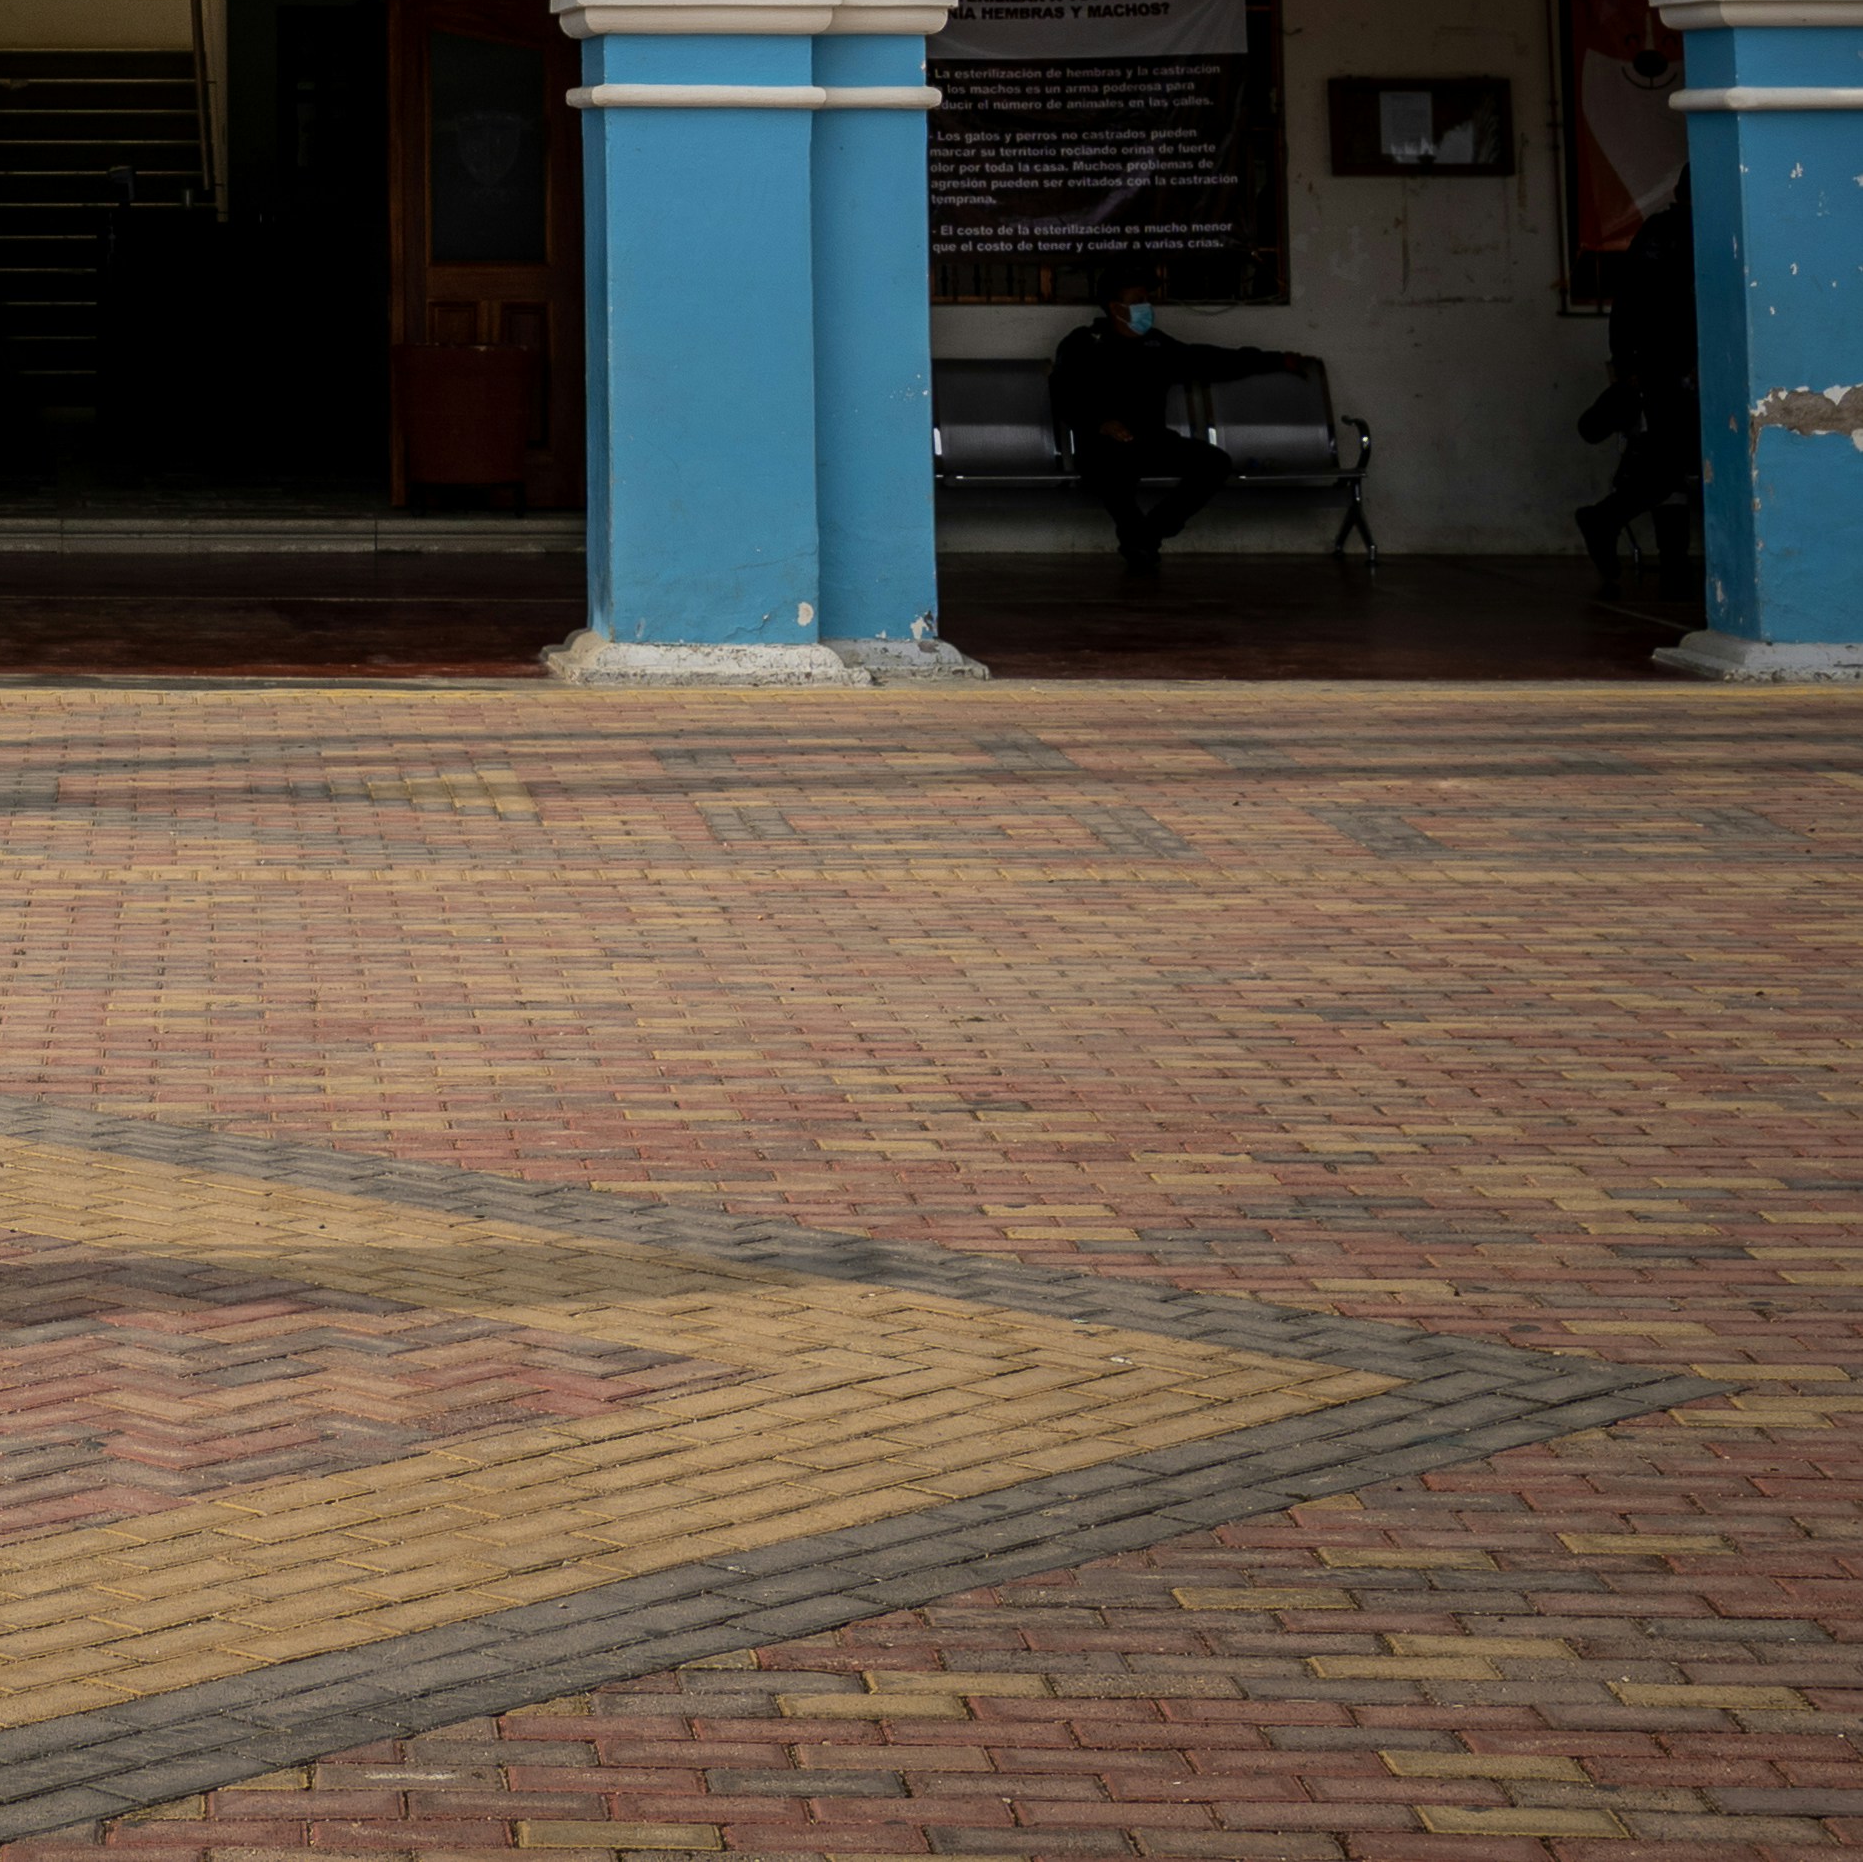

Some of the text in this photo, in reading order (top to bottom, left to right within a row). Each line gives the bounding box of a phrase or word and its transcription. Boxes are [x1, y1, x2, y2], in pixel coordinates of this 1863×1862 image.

[982, 7, 1064, 19] HEMBRAS
[1071, 7, 1082, 18] Y
[1087, 3, 1169, 18] MACHOS?
[934, 69, 950, 79] La
[1045, 68, 1062, 78] de
[1066, 67, 1122, 78] hembras
[1125, 68, 1134, 79] y
[1137, 66, 1149, 76] la
[947, 85, 965, 94] los
[970, 85, 1023, 94] machos
[1025, 85, 1041, 94] es
[1045, 85, 1061, 94] un
[1065, 83, 1099, 94] arma
[1102, 82, 1162, 94] poderosa
[1166, 81, 1195, 91] para
[978, 100, 988, 109] el
[993, 99, 1042, 109] número
[1046, 100, 1062, 109] de
[1066, 97, 1124, 109] animales
[1128, 98, 1145, 108] en
[1149, 96, 1168, 107] las
[936, 127, 1197, 144] Los gatos y perros no castrados pueden
[930, 142, 1216, 156] marcar su territorio rociando orina de fuerte
[930, 158, 1215, 174] olor por toda la casa. Muchos problemas de
[930, 178, 987, 191] agresión
[991, 179, 1039, 191] pueden
[1043, 178, 1064, 188] ser
[1067, 177, 1122, 187] evitados
[1126, 176, 1151, 186] con
[1155, 175, 1167, 185] la
[931, 195, 997, 206] temprana.
[940, 225, 953, 235] El
[957, 225, 994, 235] costo
[997, 225, 1013, 235] de
[1017, 224, 1030, 235] la
[1124, 224, 1140, 233] es
[1144, 222, 1188, 233] mucho
[1191, 222, 1233, 232] menor
[932, 242, 957, 253] que
[961, 241, 973, 251] el
[976, 241, 1013, 251] costo
[1017, 241, 1033, 251] de
[1037, 241, 1072, 250] tener
[1075, 242, 1084, 253] y
[1087, 240, 1129, 250] cuidar
[1132, 241, 1141, 250] a
[1144, 239, 1184, 249] varias
